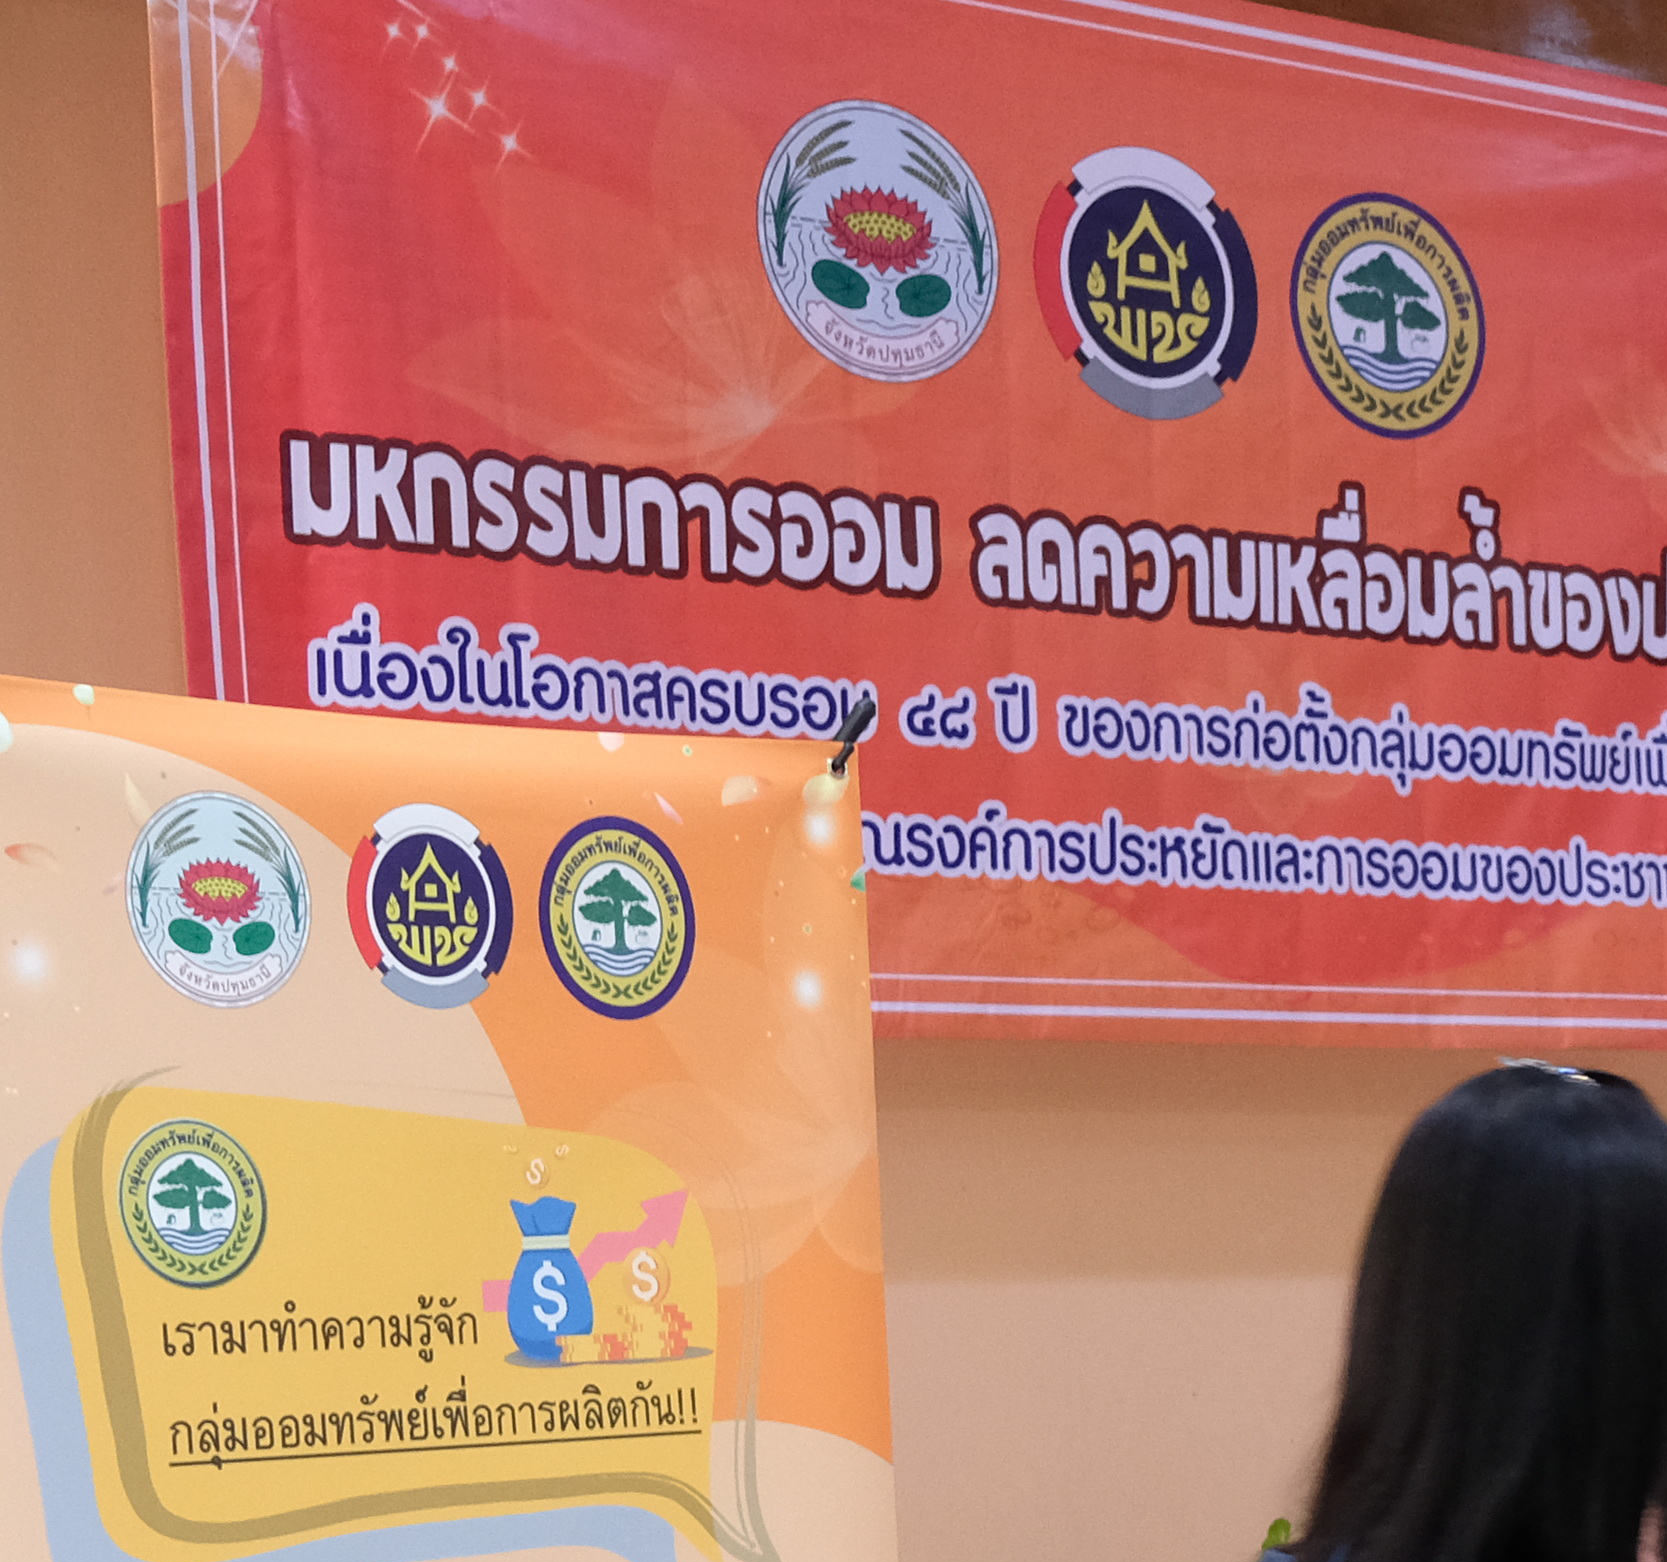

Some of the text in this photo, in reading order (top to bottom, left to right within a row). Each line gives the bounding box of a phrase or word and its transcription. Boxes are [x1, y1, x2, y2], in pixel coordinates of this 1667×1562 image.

[284, 436, 938, 596] มหกรรมการออม
[906, 693, 970, 740] ๔๘
[995, 681, 1031, 743] ปี
[160, 1297, 479, 1364] เรามาทำความรู้จัก
[168, 1375, 699, 1468] กลุ่มออมทรัพย์เพื่อการผลิตกัน!!
